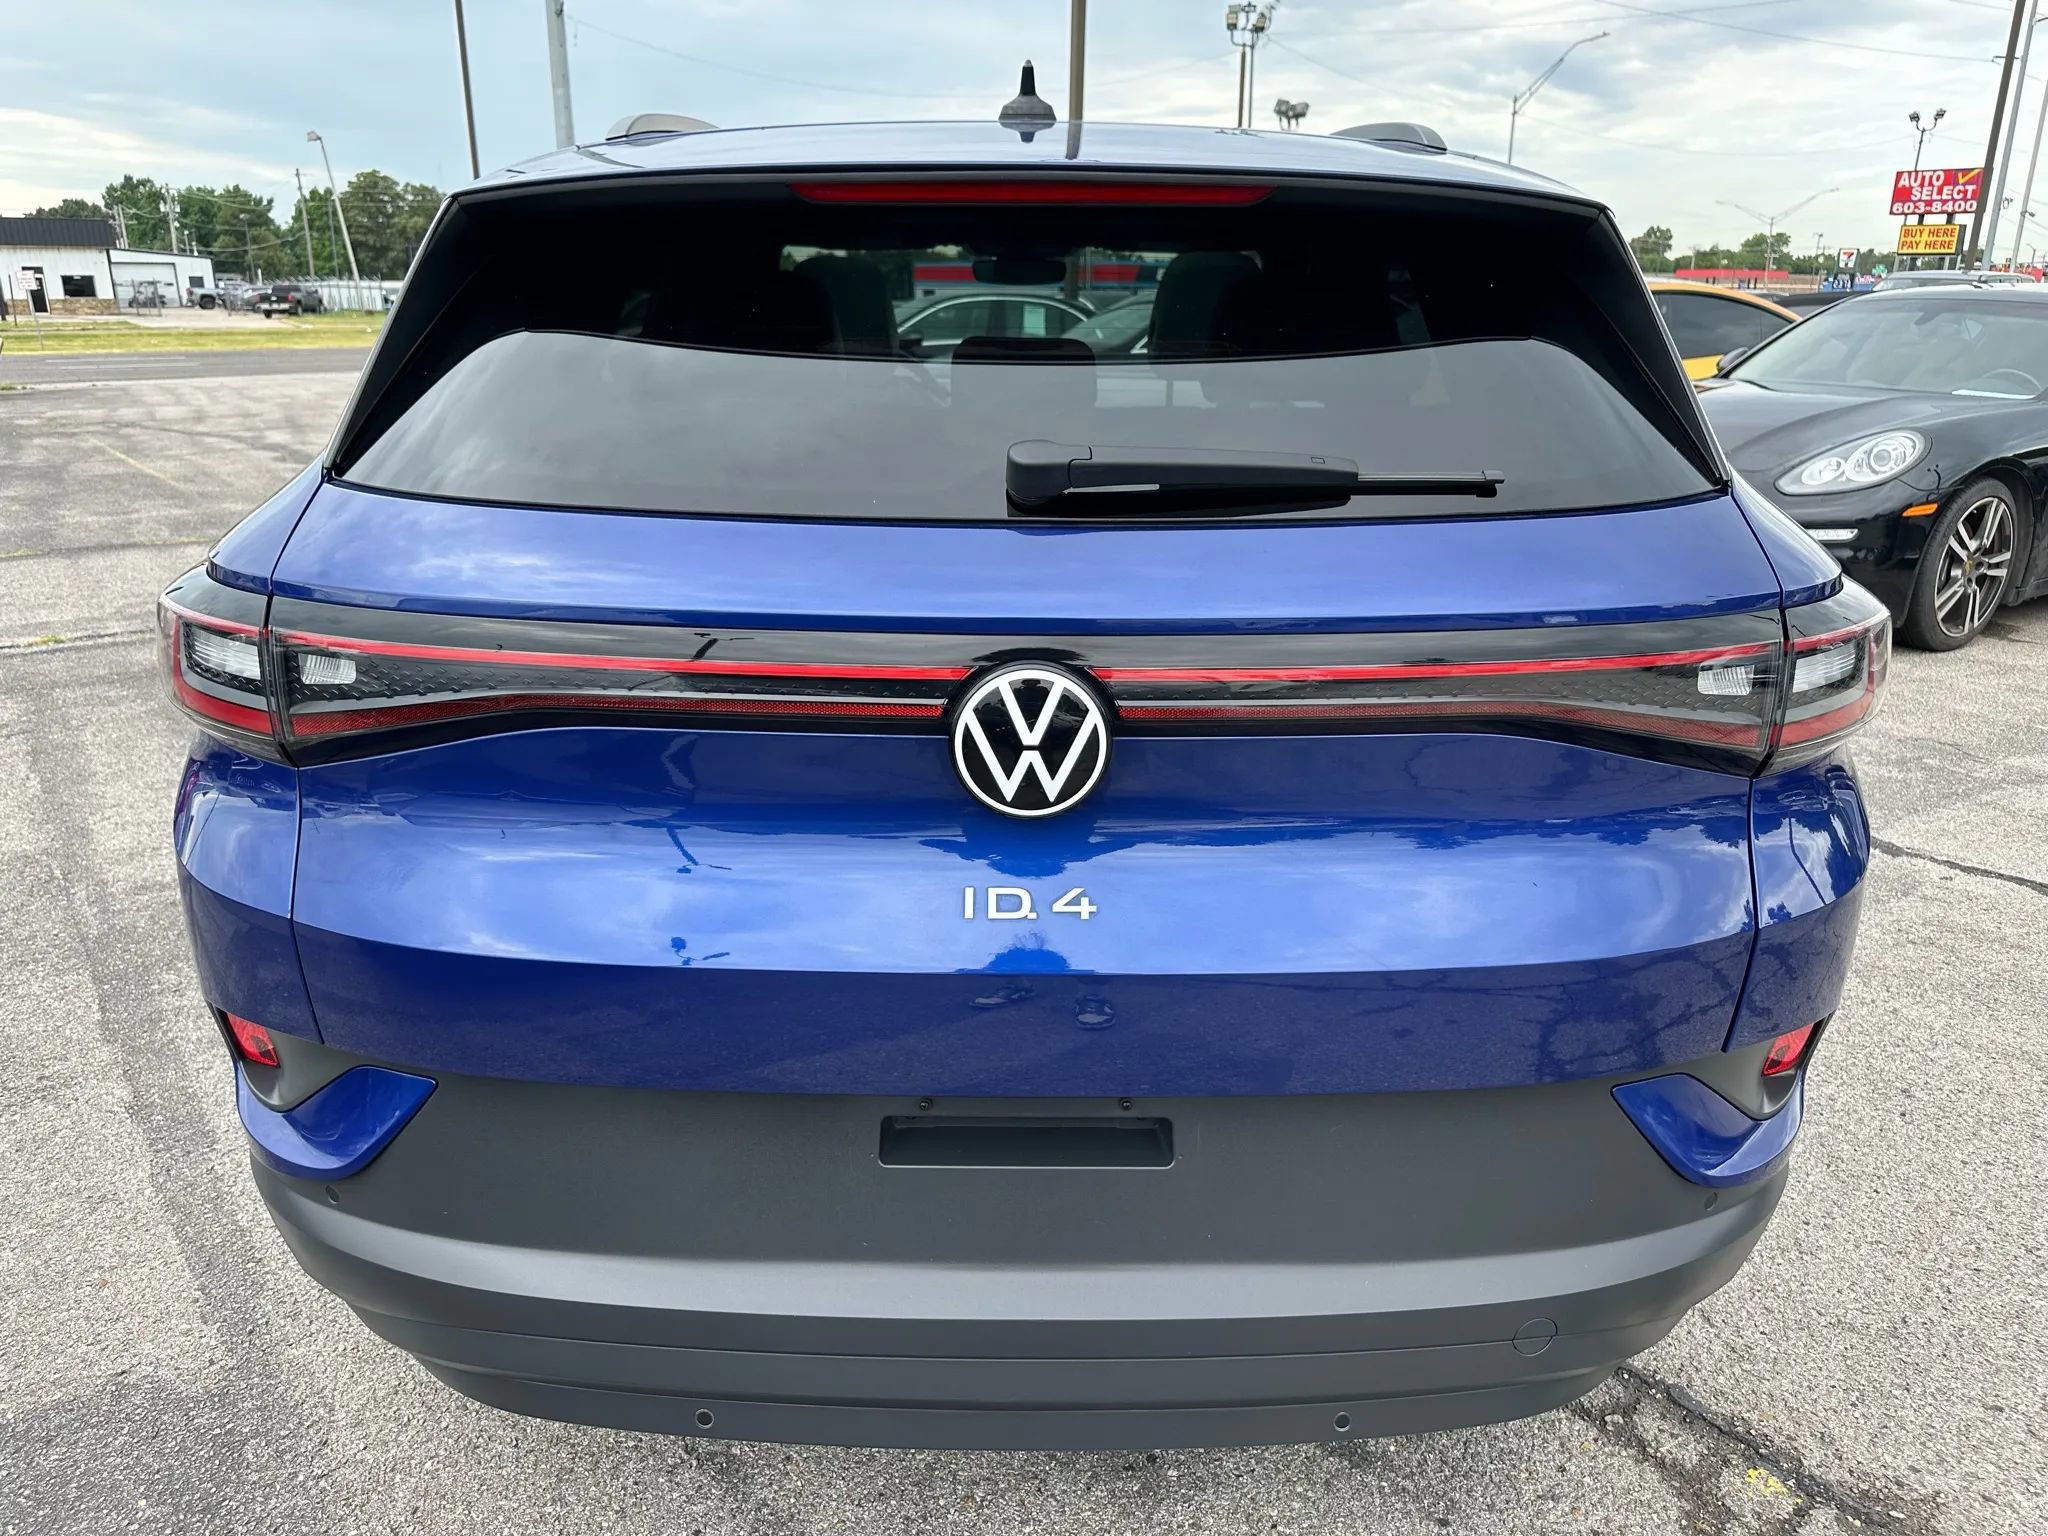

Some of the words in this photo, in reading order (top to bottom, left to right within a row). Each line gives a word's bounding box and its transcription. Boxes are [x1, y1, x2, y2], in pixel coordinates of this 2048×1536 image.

[1898, 170, 1945, 188] AUTO
[1910, 184, 1977, 201] SELECT
[1892, 200, 1977, 214] 603-8400
[1903, 228, 1925, 238] BUY
[1927, 227, 1957, 238] HERE
[1900, 240, 1922, 250] PAY
[1924, 239, 1954, 250] HERE
